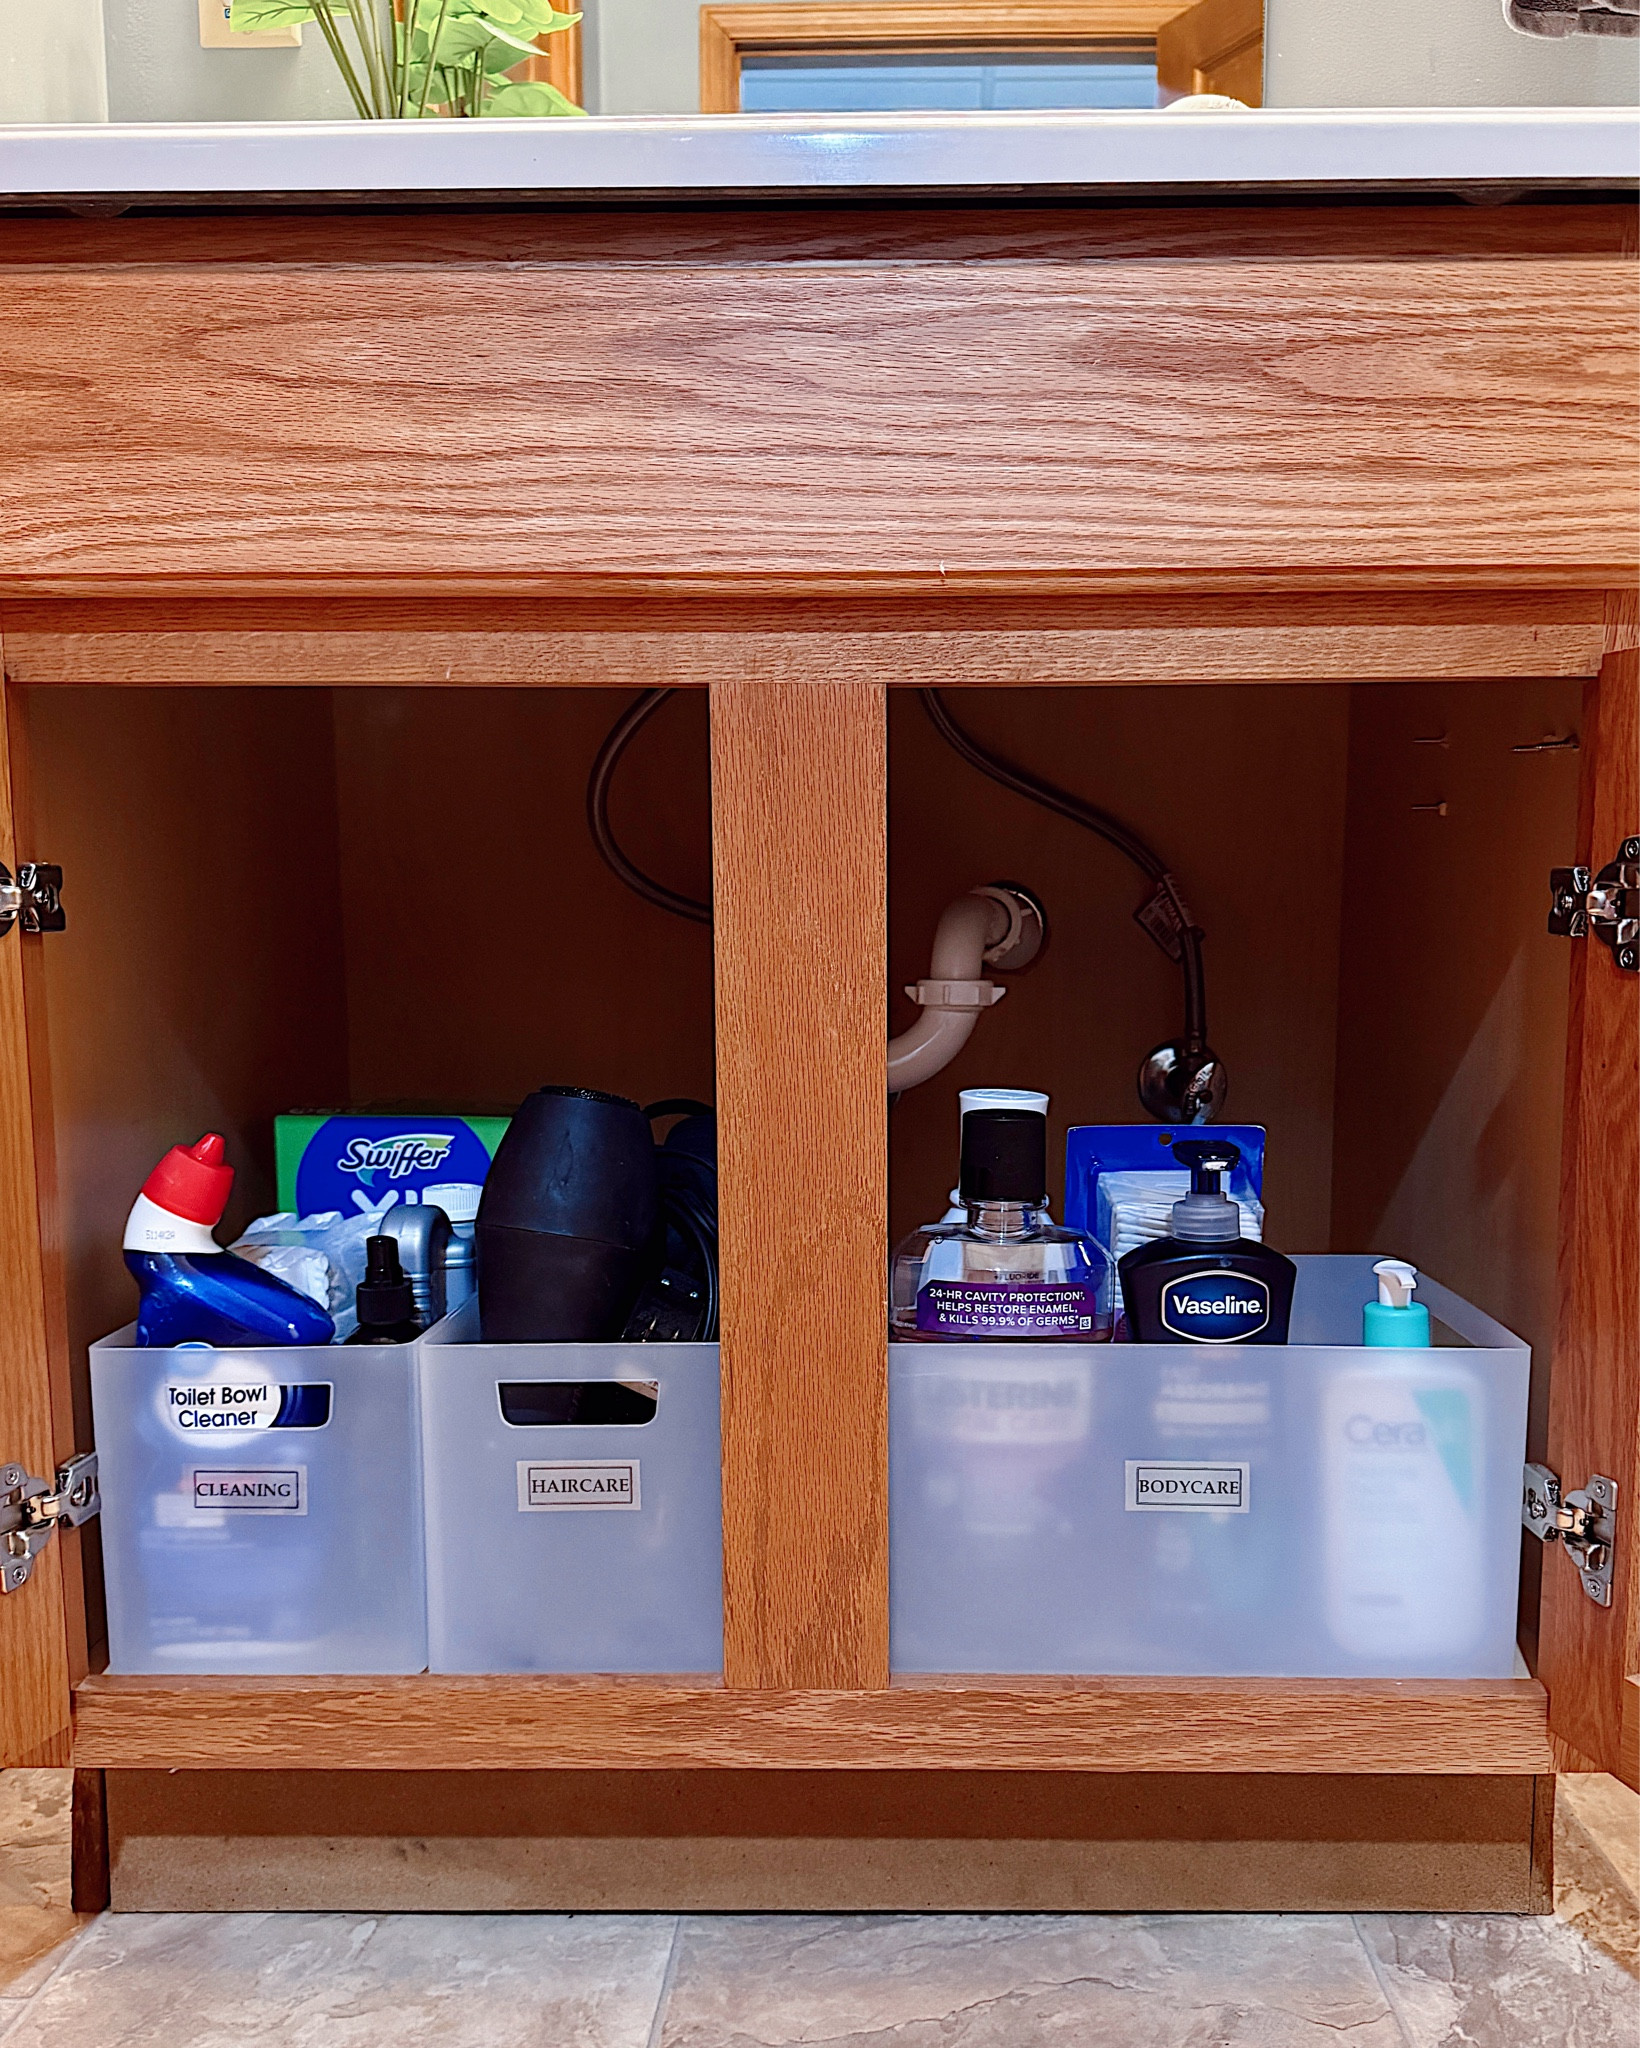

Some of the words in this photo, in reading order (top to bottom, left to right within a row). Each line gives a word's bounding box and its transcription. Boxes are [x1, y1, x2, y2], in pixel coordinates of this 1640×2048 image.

[338, 1138, 450, 1178] Swiffer
[929, 1288, 962, 1300] 24-HR
[964, 1291, 1007, 1302] CAVITY
[936, 1300, 972, 1313] HELPS
[974, 1303, 1027, 1315] RESTORE
[939, 1312, 947, 1323] &
[949, 1313, 979, 1325] KILLS
[981, 1315, 1016, 1326] 99.9%
[1017, 1316, 1034, 1326] OF
[169, 1387, 216, 1406] Toilet
[221, 1385, 267, 1405] Bowl
[179, 1409, 258, 1428] Cleaner
[196, 1483, 291, 1497] CLEANING
[531, 1478, 629, 1493] HAIRCARE
[1139, 1480, 1239, 1495] BODYCARE
